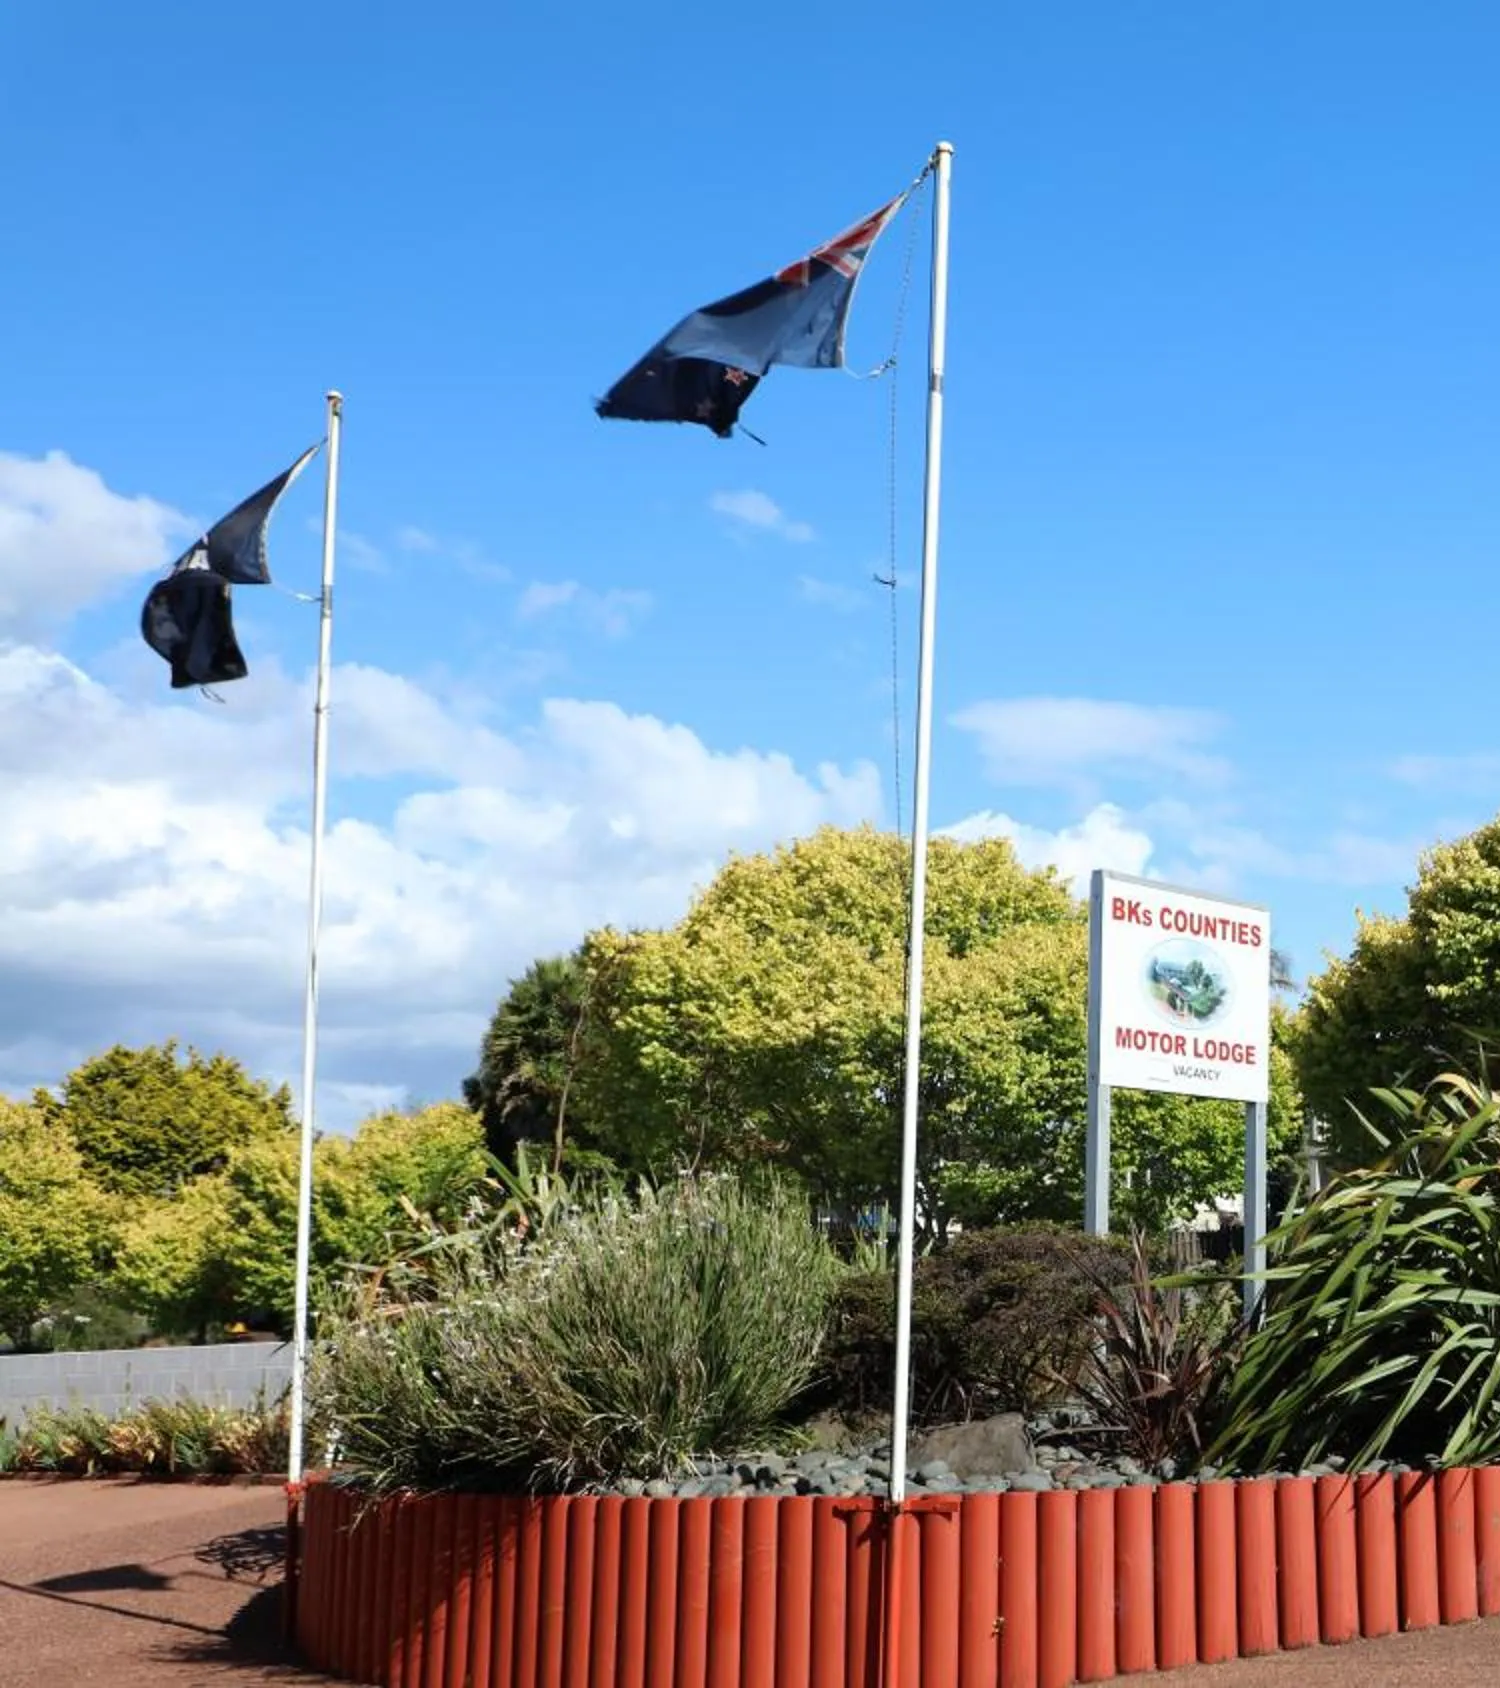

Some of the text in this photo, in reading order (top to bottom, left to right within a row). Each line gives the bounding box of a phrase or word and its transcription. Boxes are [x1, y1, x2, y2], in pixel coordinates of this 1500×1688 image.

[1112, 897, 1261, 947] BKs COUNTIES
[1115, 1027, 1256, 1065] MOTOR LODGE
[1173, 1066, 1221, 1082] VACANCY
